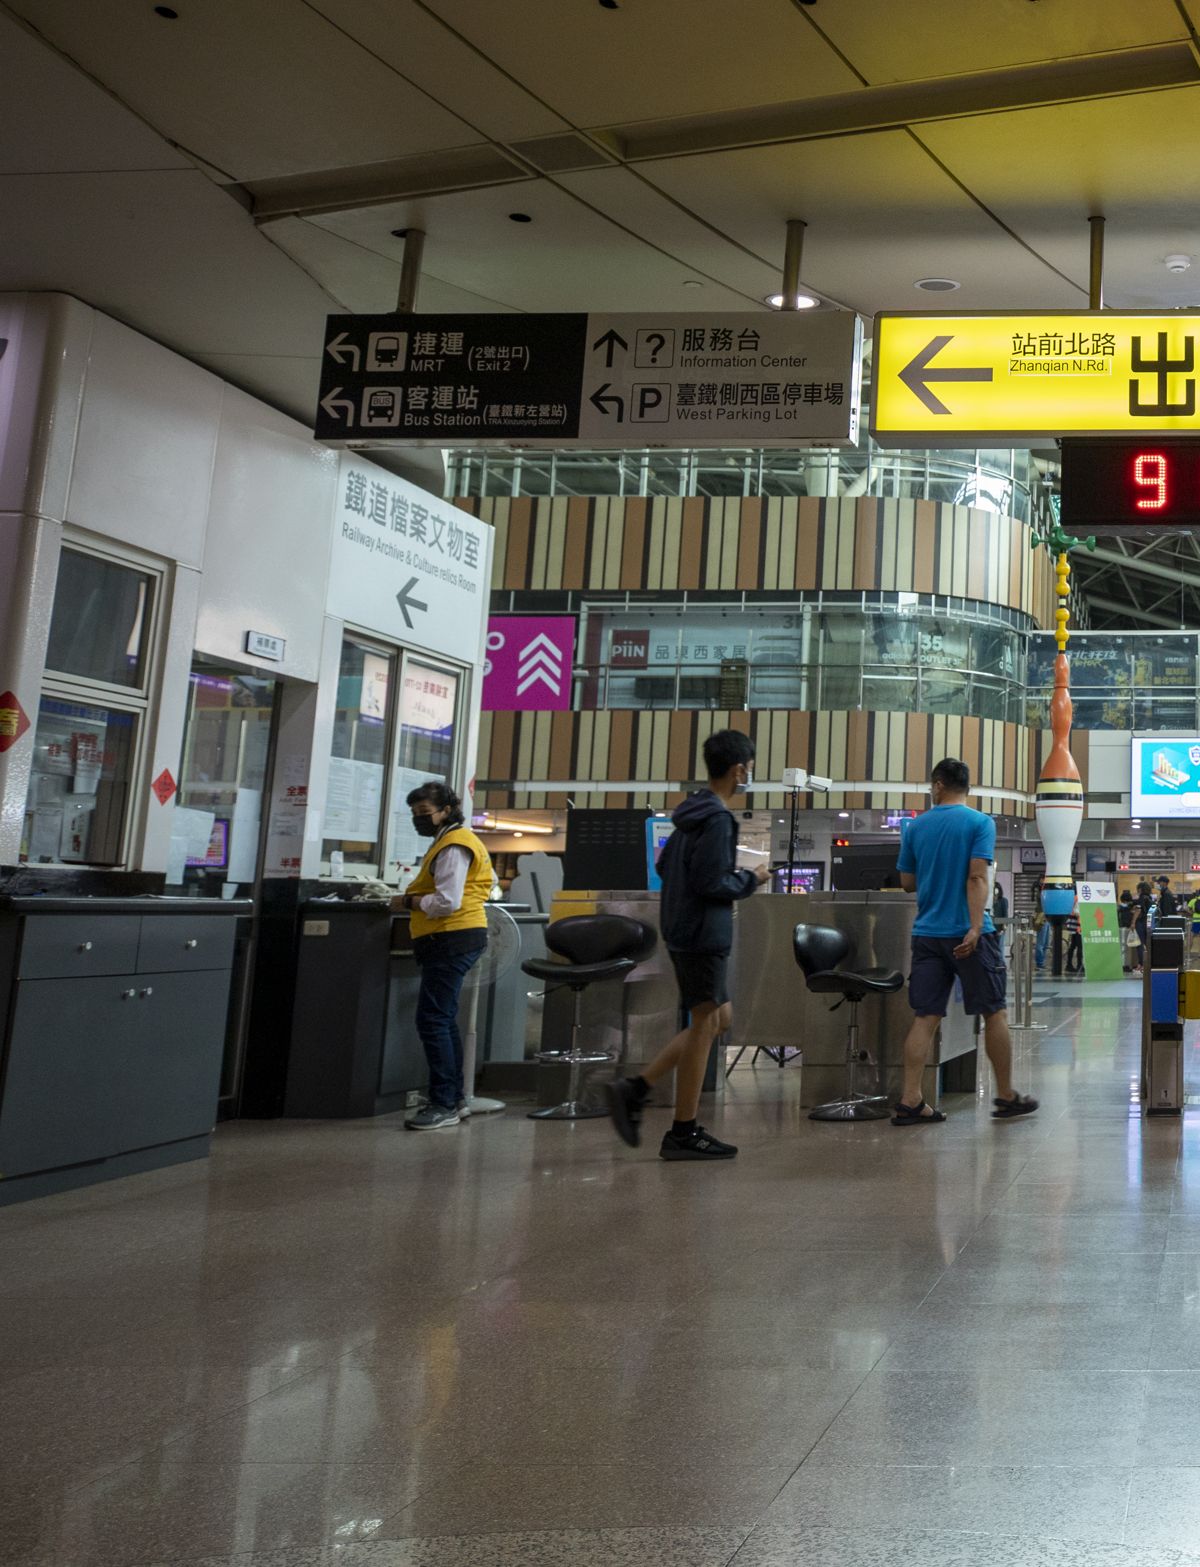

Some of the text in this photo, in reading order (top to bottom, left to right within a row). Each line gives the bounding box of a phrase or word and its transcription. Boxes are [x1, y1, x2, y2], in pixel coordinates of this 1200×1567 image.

[412, 331, 465, 356] 捷運
[682, 328, 760, 351] 服務台
[1011, 332, 1116, 357] 站前北路
[410, 359, 445, 372] MRT
[477, 360, 511, 372] Exit 2
[680, 354, 808, 368] Information Center
[1010, 359, 1069, 374] Zhanqian
[407, 385, 480, 411] 客運站
[676, 383, 844, 406] 臺鐵側西區停車場
[403, 412, 481, 426] Bus Station
[538, 417, 560, 425] Station
[676, 407, 798, 423] West Parking Lot
[1134, 454, 1167, 508] 9
[344, 470, 481, 570] 鐵道檔案文物室
[342, 522, 477, 594] Railway Archive & Culture relics Room
